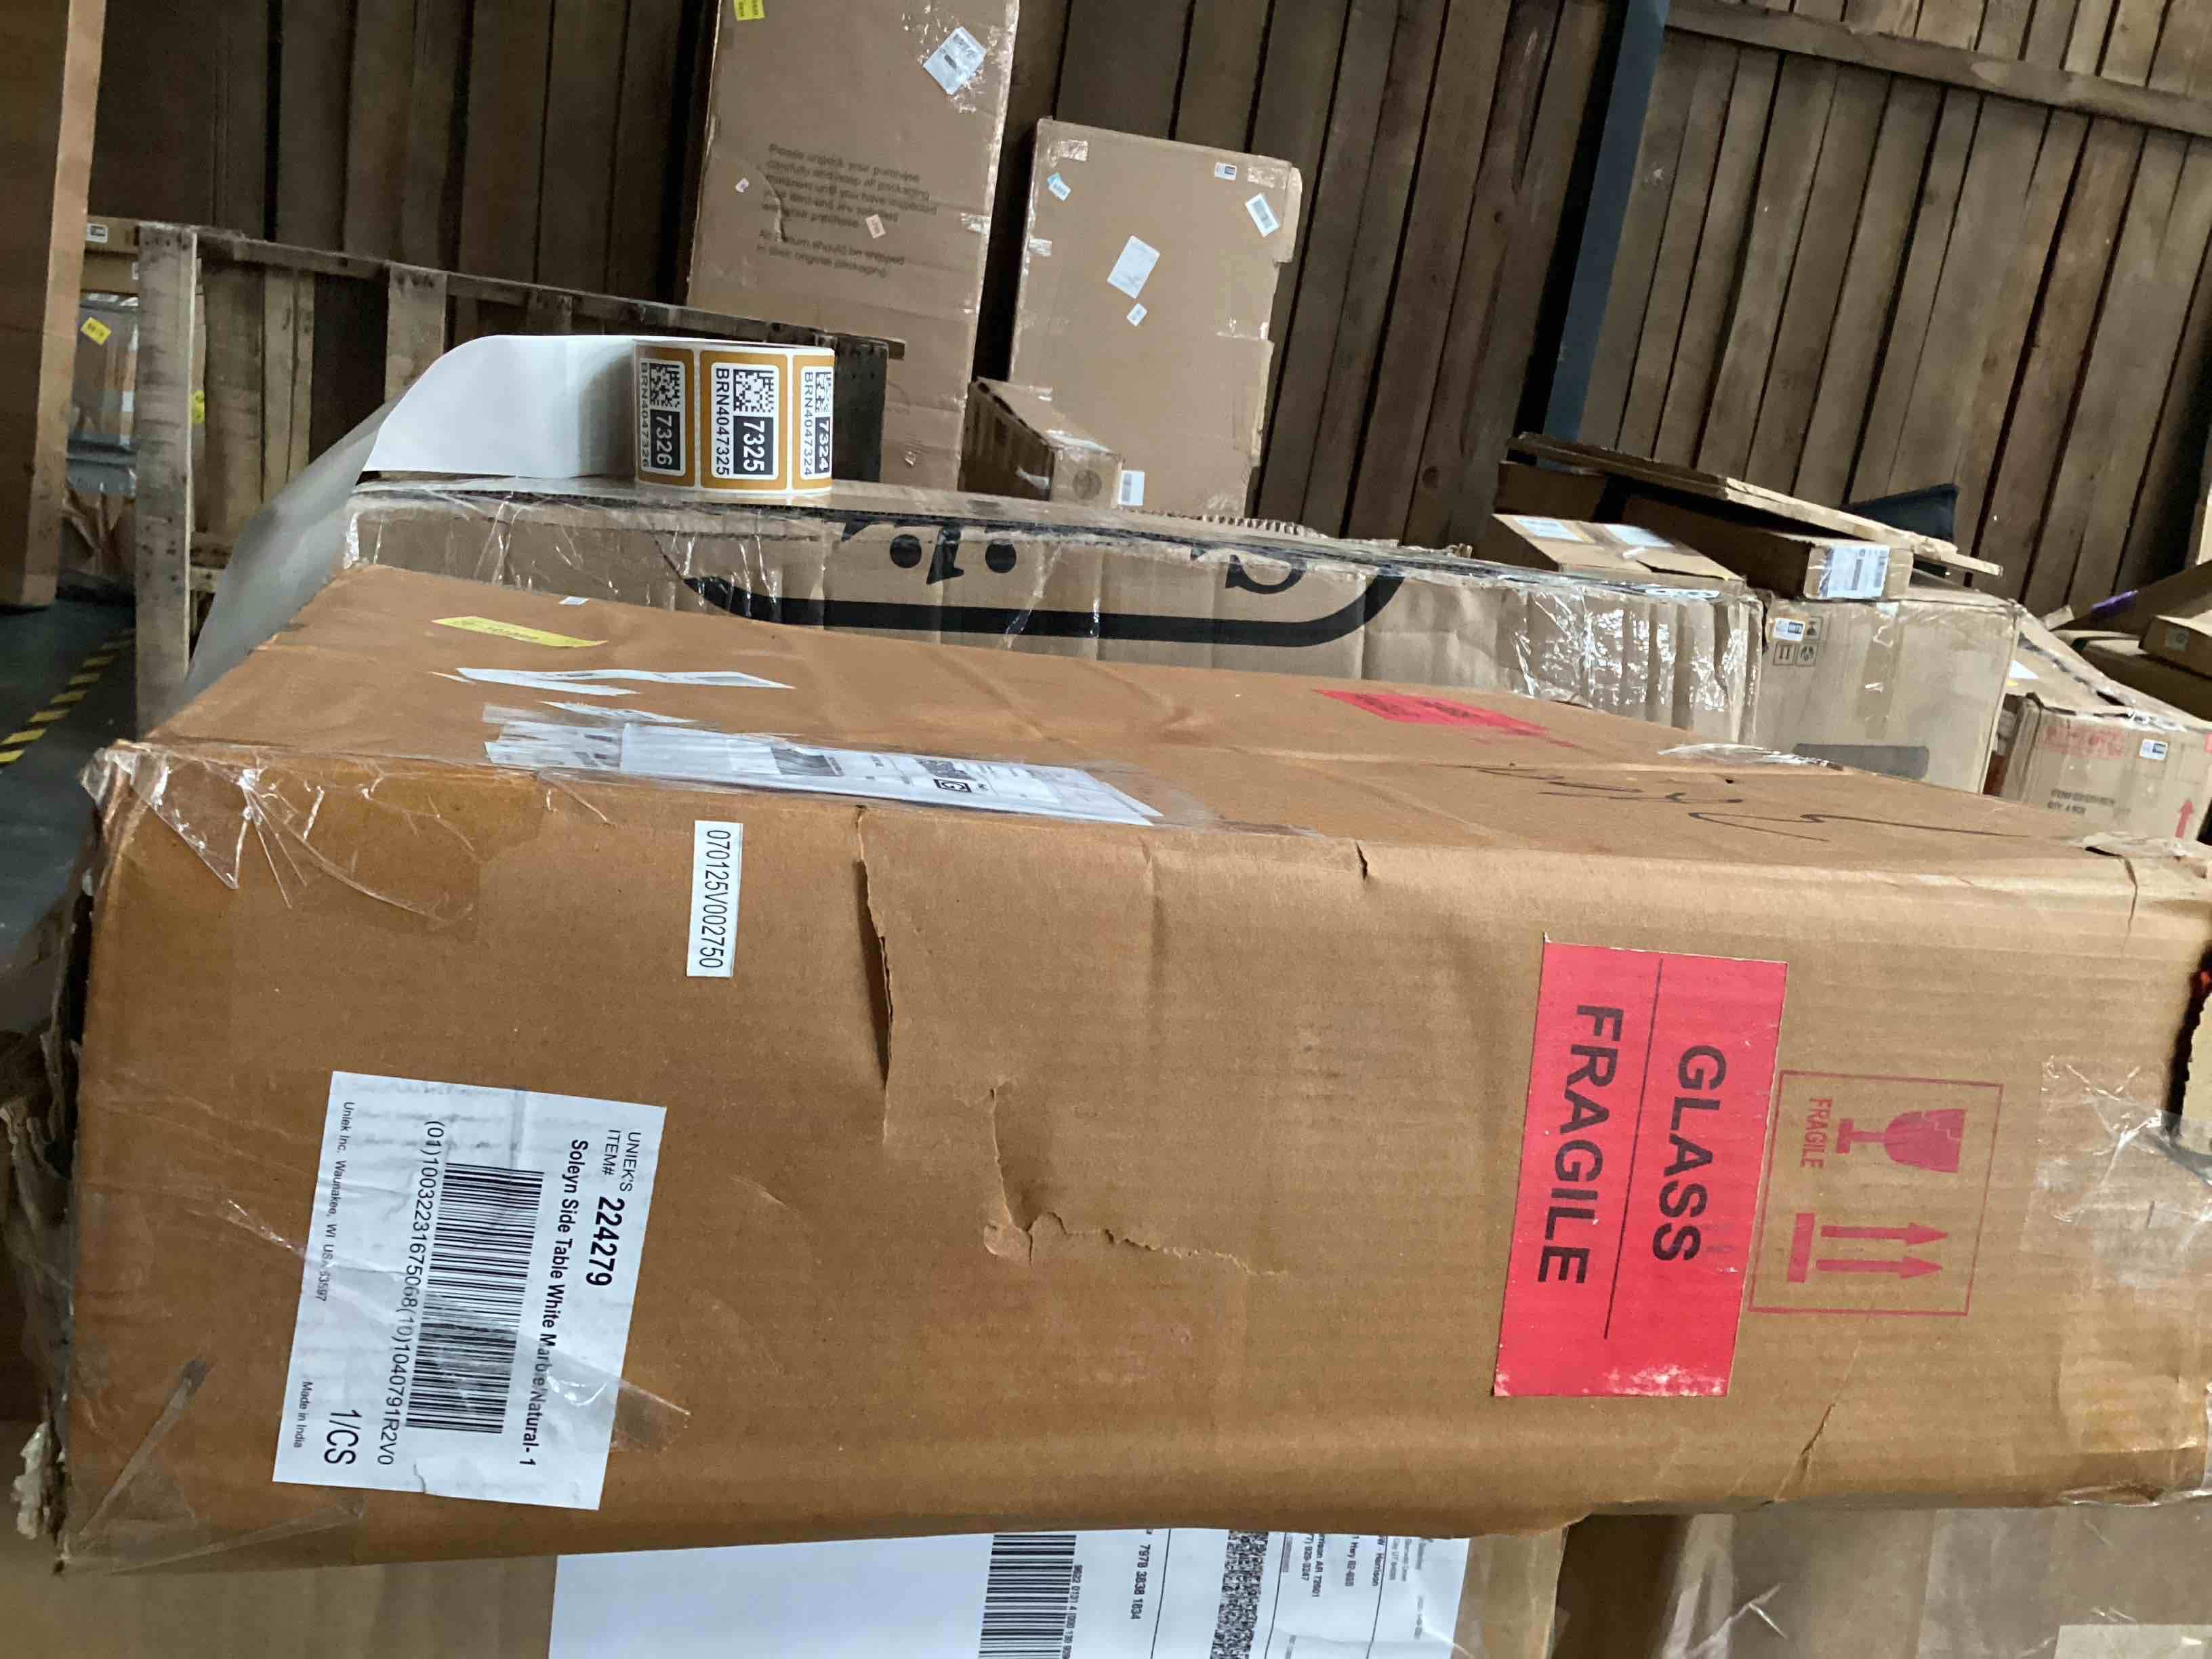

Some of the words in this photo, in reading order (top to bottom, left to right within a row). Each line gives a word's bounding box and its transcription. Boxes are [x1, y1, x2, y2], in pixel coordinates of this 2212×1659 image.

[656, 415, 672, 466] 7326
[716, 368, 730, 476] BRN4047325
[743, 420, 765, 472] 7325
[804, 372, 813, 475] BRN4047324
[818, 420, 830, 470] 7324
[699, 830, 731, 968] 070125V002750
[340, 1101, 356, 1132] Uniek
[1800, 1098, 1833, 1169] FRAGILE
[336, 1135, 350, 1153] Inc.
[562, 1139, 589, 1193] Soleyn
[601, 1129, 621, 1176] ITEM#
[619, 1132, 642, 1192] UNIEK'S
[1538, 1004, 1624, 1284] FRAGILE
[1652, 1045, 1727, 1261] GLASS
[325, 1160, 347, 1217] Waunakee,
[325, 1223, 337, 1238] WI
[558, 1198, 579, 1233] Side
[550, 1238, 573, 1279] Table
[586, 1196, 625, 1286] 224279
[542, 1284, 565, 1328] White
[298, 1412, 309, 1422] in
[299, 1381, 314, 1410] Made
[293, 1423, 308, 1448] India
[324, 1409, 363, 1465] 1/CS
[1314, 1561, 1324, 1573] AR
[1347, 1541, 1360, 1558] Hwy
[1371, 1552, 1386, 1587] Harrison
